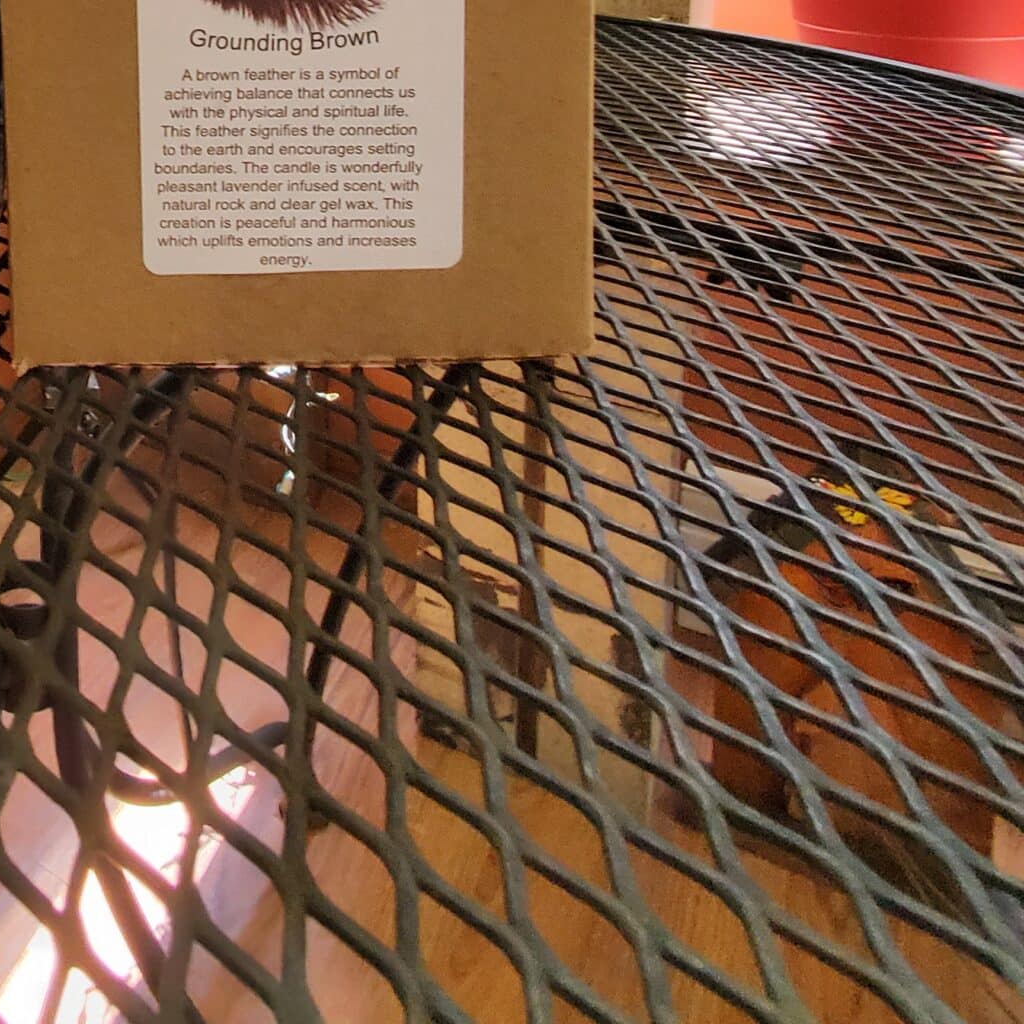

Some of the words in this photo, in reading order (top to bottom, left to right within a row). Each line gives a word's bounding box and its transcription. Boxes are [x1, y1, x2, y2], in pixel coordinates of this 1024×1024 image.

[189, 29, 303, 55] Grounding
[310, 30, 379, 50] Brown
[181, 68, 193, 81] A
[196, 69, 240, 82] brown
[243, 67, 297, 81] feather
[299, 68, 312, 81] is
[315, 70, 325, 80] a
[328, 67, 381, 83] symbol
[384, 66, 401, 80] of
[163, 87, 233, 103] achieving
[236, 87, 294, 100] balance
[297, 87, 325, 99] that
[328, 86, 395, 99] connects
[398, 88, 416, 98] us
[169, 106, 199, 119] with
[202, 106, 226, 119] the
[229, 105, 288, 122] physical
[291, 105, 319, 118] and
[323, 104, 380, 120] spiritual
[383, 104, 409, 118] life.
[160, 124, 192, 138] This
[195, 124, 247, 137] feather
[249, 123, 308, 140] signifies
[312, 124, 335, 137] the
[339, 123, 418, 136] connection
[162, 144, 177, 156] to
[179, 143, 203, 156] the
[206, 143, 244, 156] earth
[247, 143, 275, 156] and
[278, 145, 364, 158] encourages
[367, 142, 415, 158] setting
[154, 161, 237, 175] boundaries.
[241, 161, 269, 174] The
[273, 161, 321, 174] candle
[325, 160, 337, 174] is
[340, 160, 423, 176] wonderfully
[157, 180, 218, 195] pleasant
[221, 179, 284, 192] lavender
[287, 179, 339, 192] infused
[389, 179, 420, 192] with
[162, 198, 211, 211] natural
[215, 198, 246, 211] rock
[249, 198, 276, 211] and
[280, 198, 317, 210] clear
[319, 197, 342, 213] gel
[344, 200, 379, 210] wax.
[382, 197, 414, 210] This
[159, 217, 216, 229] creation
[219, 216, 232, 229] is
[235, 215, 297, 232] peaceful
[300, 216, 328, 229] and
[331, 215, 416, 229] harmonious
[157, 234, 198, 247] which
[202, 233, 244, 249] uplifts
[247, 234, 313, 248] emotions
[316, 234, 344, 247] and
[347, 234, 417, 247] increases
[259, 254, 313, 269] energy.
